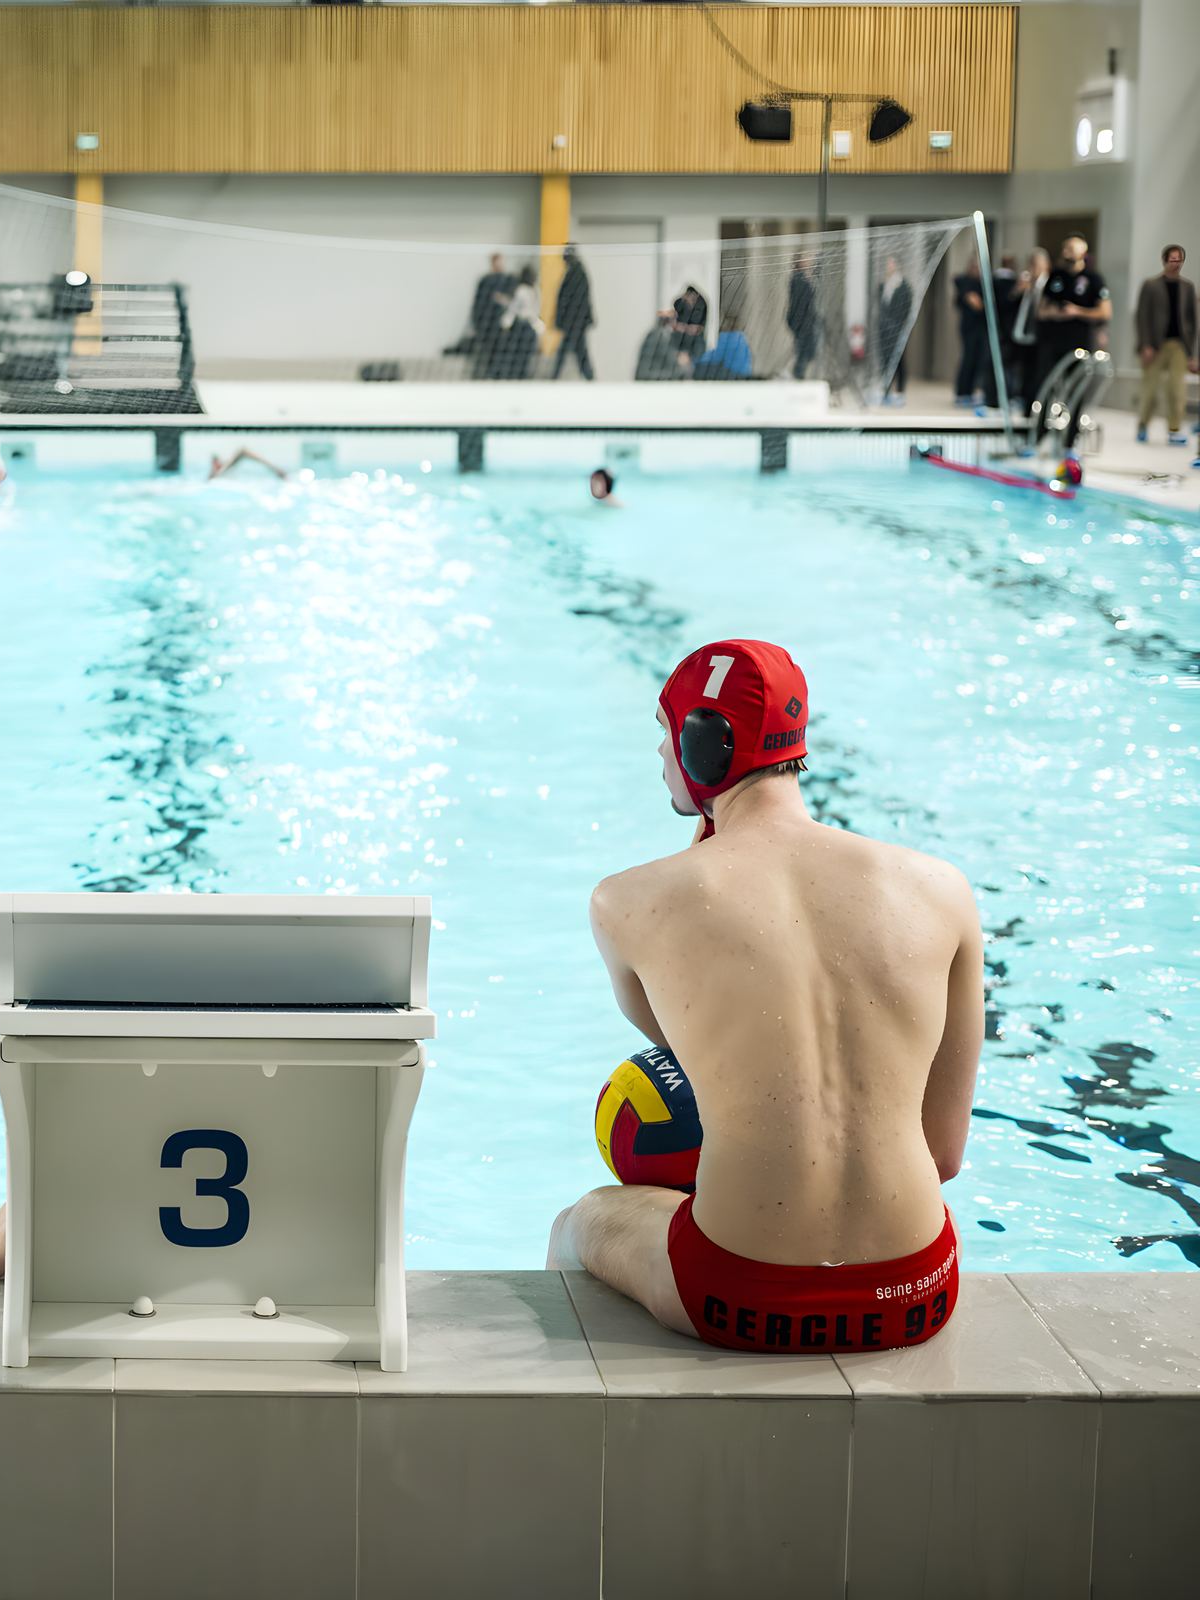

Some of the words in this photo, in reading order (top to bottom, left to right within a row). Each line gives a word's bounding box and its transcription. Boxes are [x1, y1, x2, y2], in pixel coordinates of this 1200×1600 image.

[703, 655, 735, 699] 1
[763, 727, 802, 750] CERCLE
[640, 1048, 684, 1092] WATK
[158, 1128, 251, 1248] 3
[703, 1294, 884, 1347] CERCLE
[904, 1290, 948, 1339] 93
